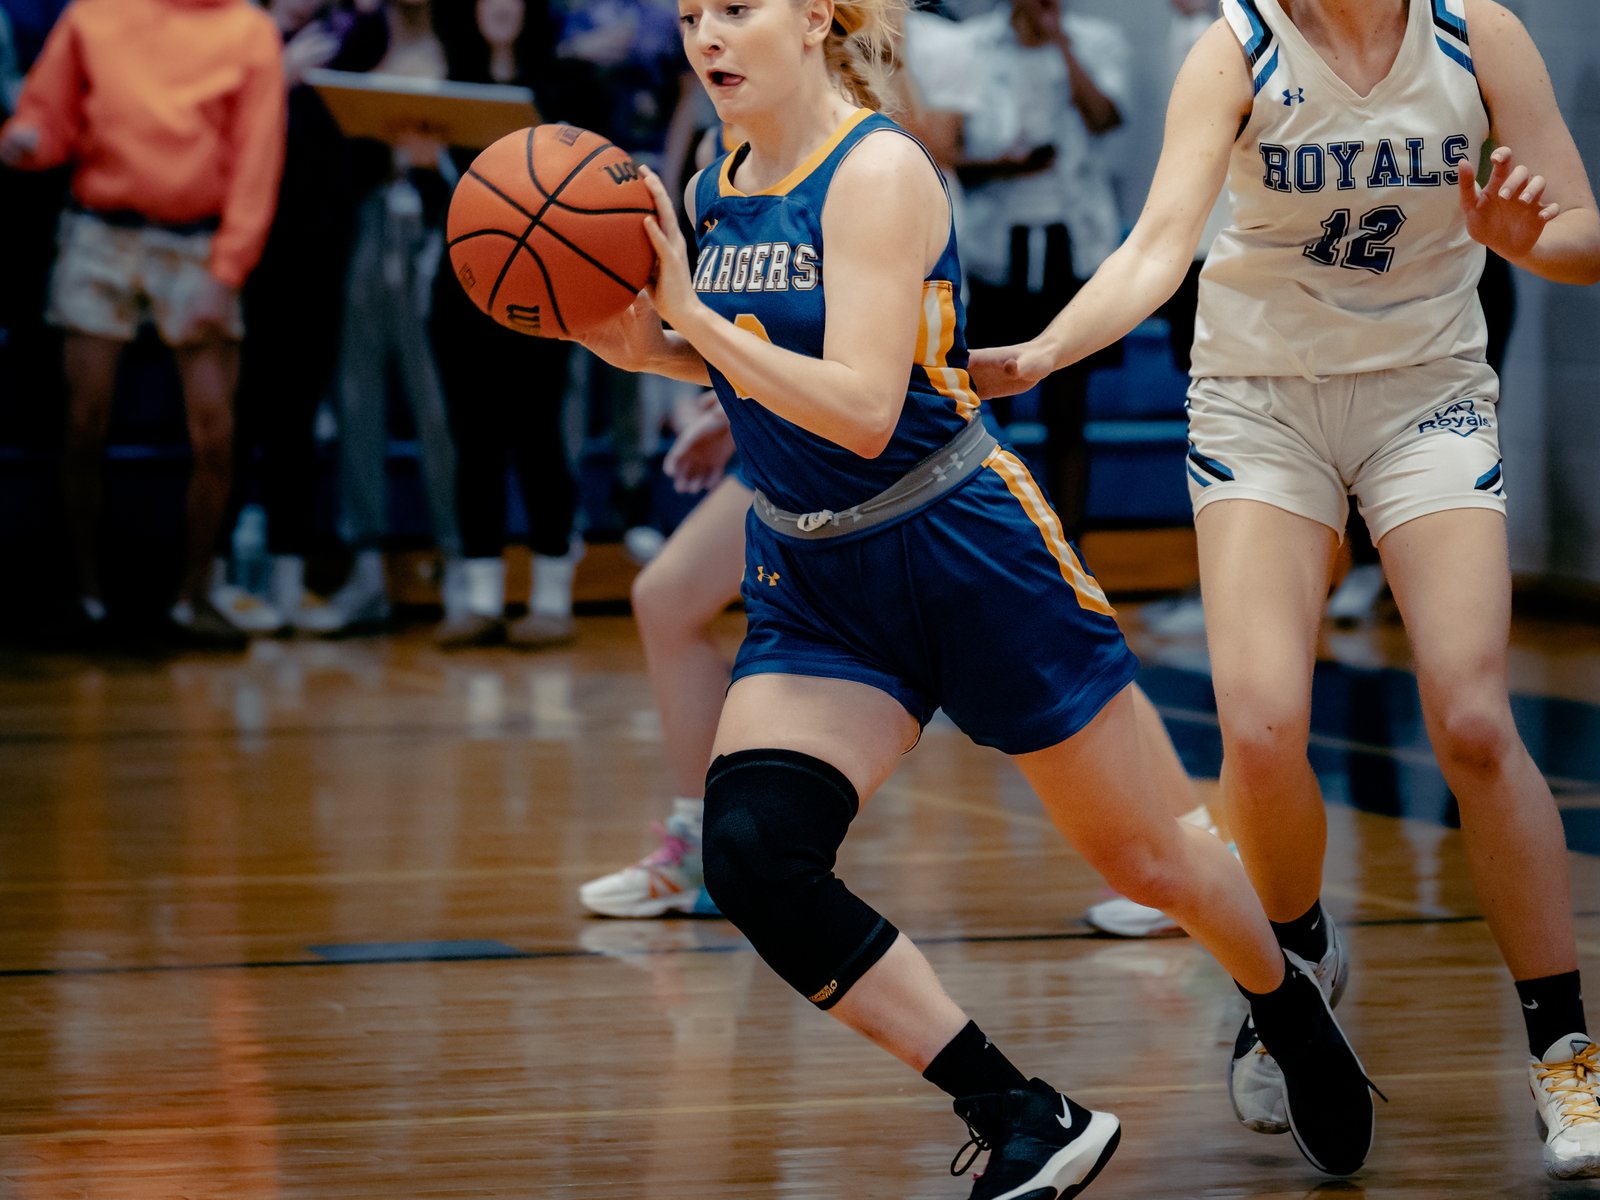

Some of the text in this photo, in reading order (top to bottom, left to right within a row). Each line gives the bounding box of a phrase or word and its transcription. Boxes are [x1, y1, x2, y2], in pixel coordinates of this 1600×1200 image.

[1259, 134, 1468, 193] ROYALS
[693, 241, 819, 293] ARGERS
[1302, 205, 1407, 275] 12
